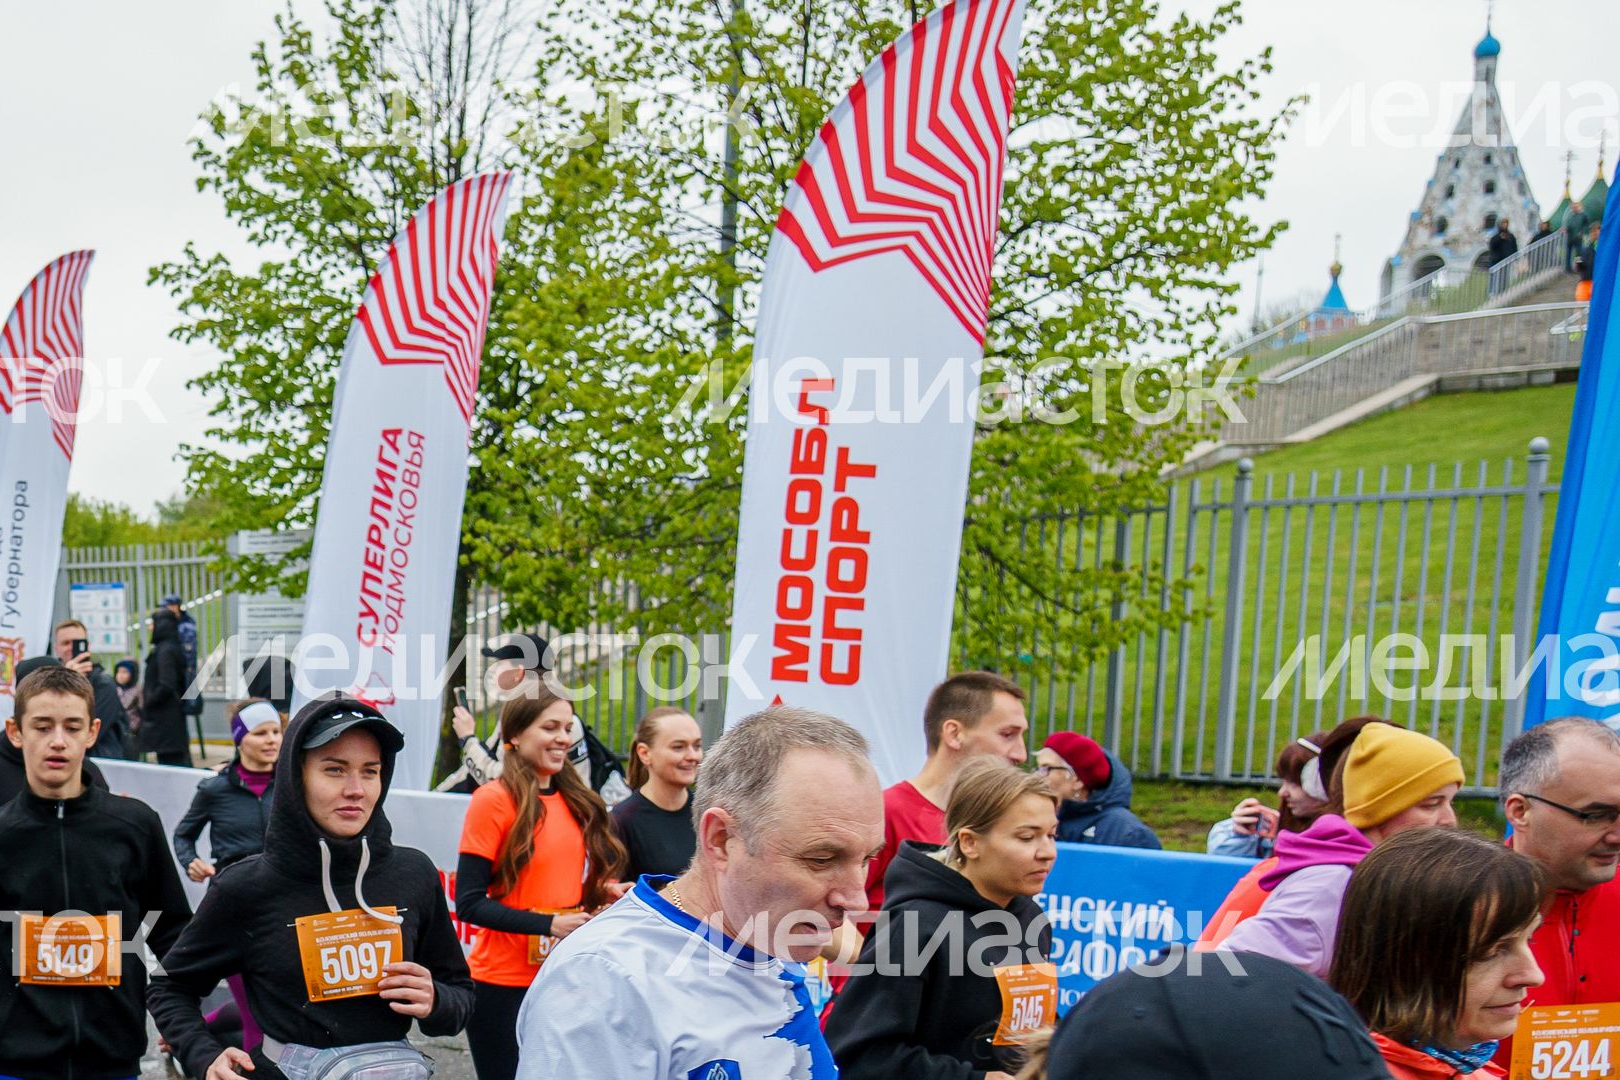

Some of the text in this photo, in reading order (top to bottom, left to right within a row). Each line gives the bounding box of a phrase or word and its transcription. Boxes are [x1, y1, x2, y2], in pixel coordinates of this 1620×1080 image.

[357, 427, 405, 648] СУПЕРЛИГА
[379, 429, 426, 656] ПОДМОСКОВЬЯ
[773, 378, 836, 683] МОСОБЛ
[820, 446, 877, 686] СПОРТ
[37, 943, 94, 974] 5149
[320, 941, 391, 984] 5097
[1010, 995, 1044, 1031] 5145
[1531, 1038, 1611, 1080] 5244
